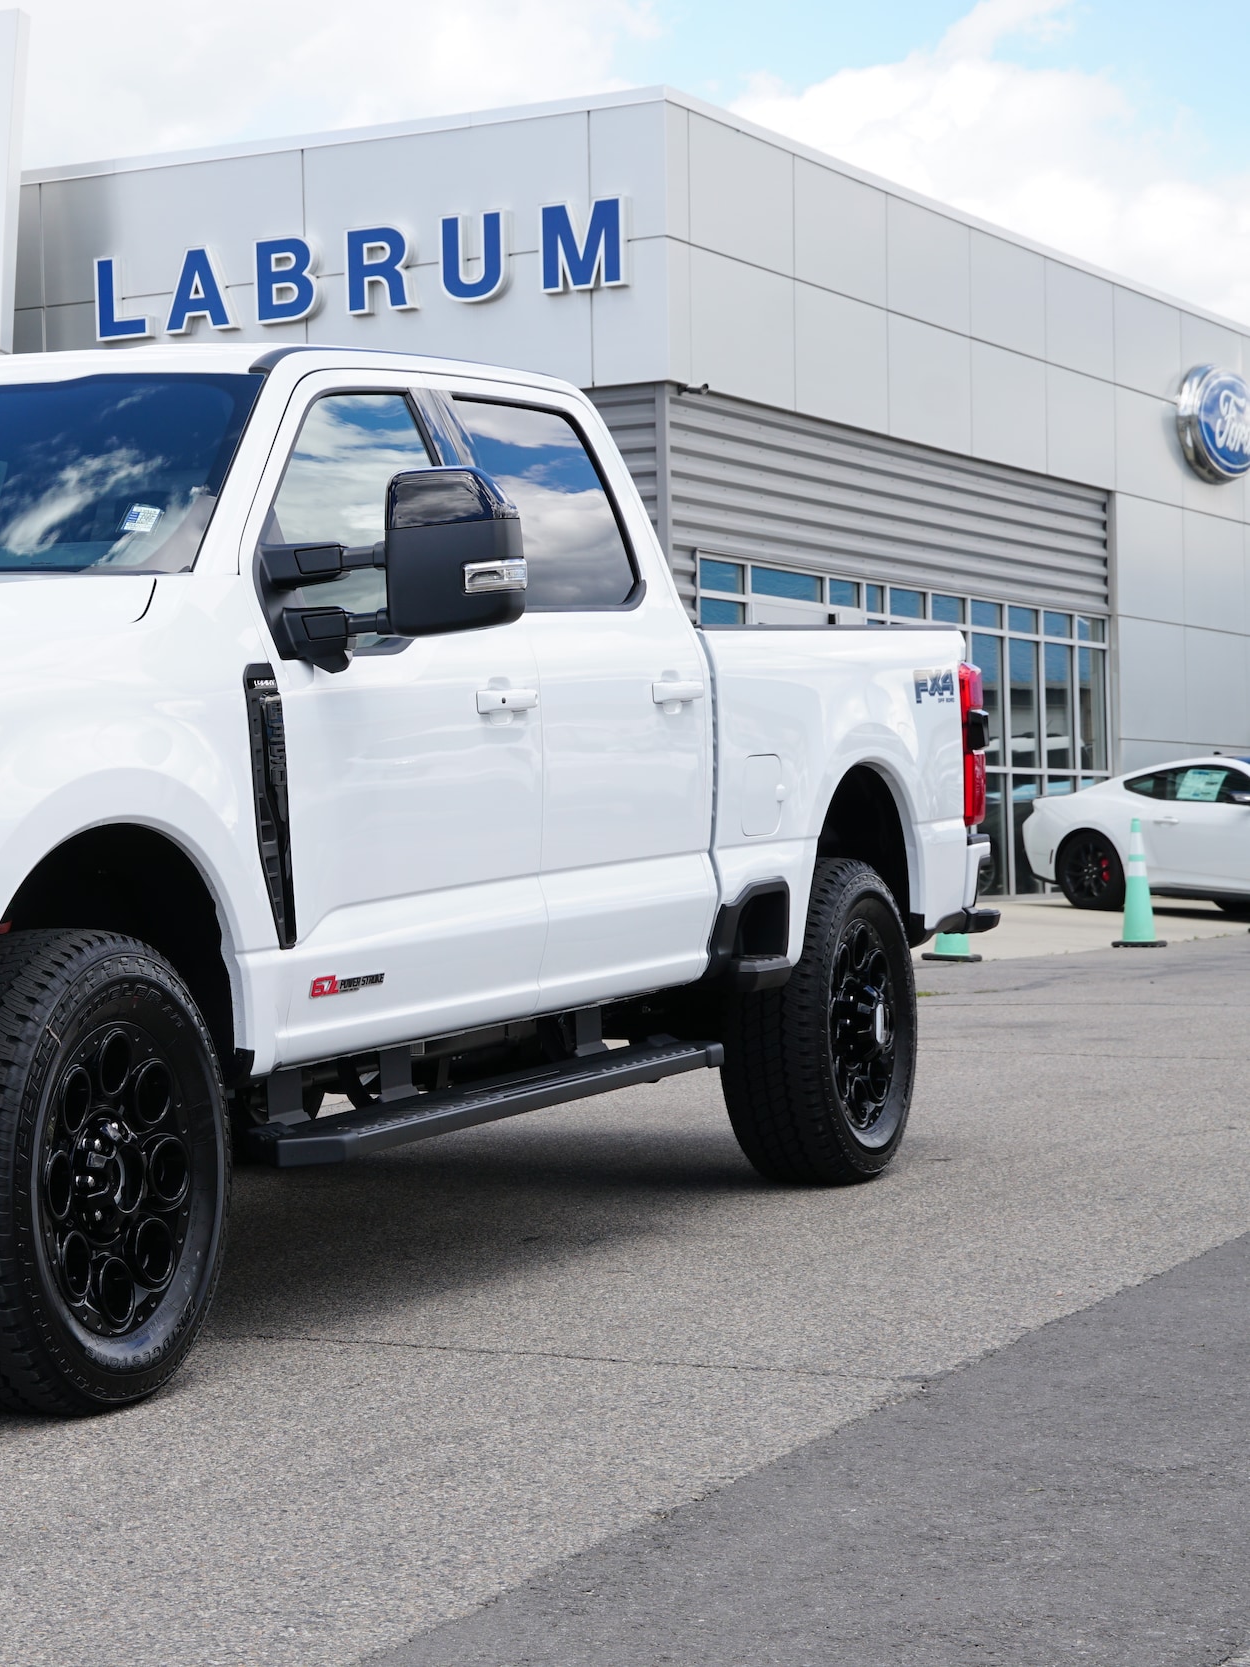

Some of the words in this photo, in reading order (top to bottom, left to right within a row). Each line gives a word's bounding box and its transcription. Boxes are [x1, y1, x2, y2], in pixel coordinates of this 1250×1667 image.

[94, 195, 626, 342] LABRUM
[913, 669, 954, 704] FX4
[85, 1296, 196, 1370] BRIDGESTONE
